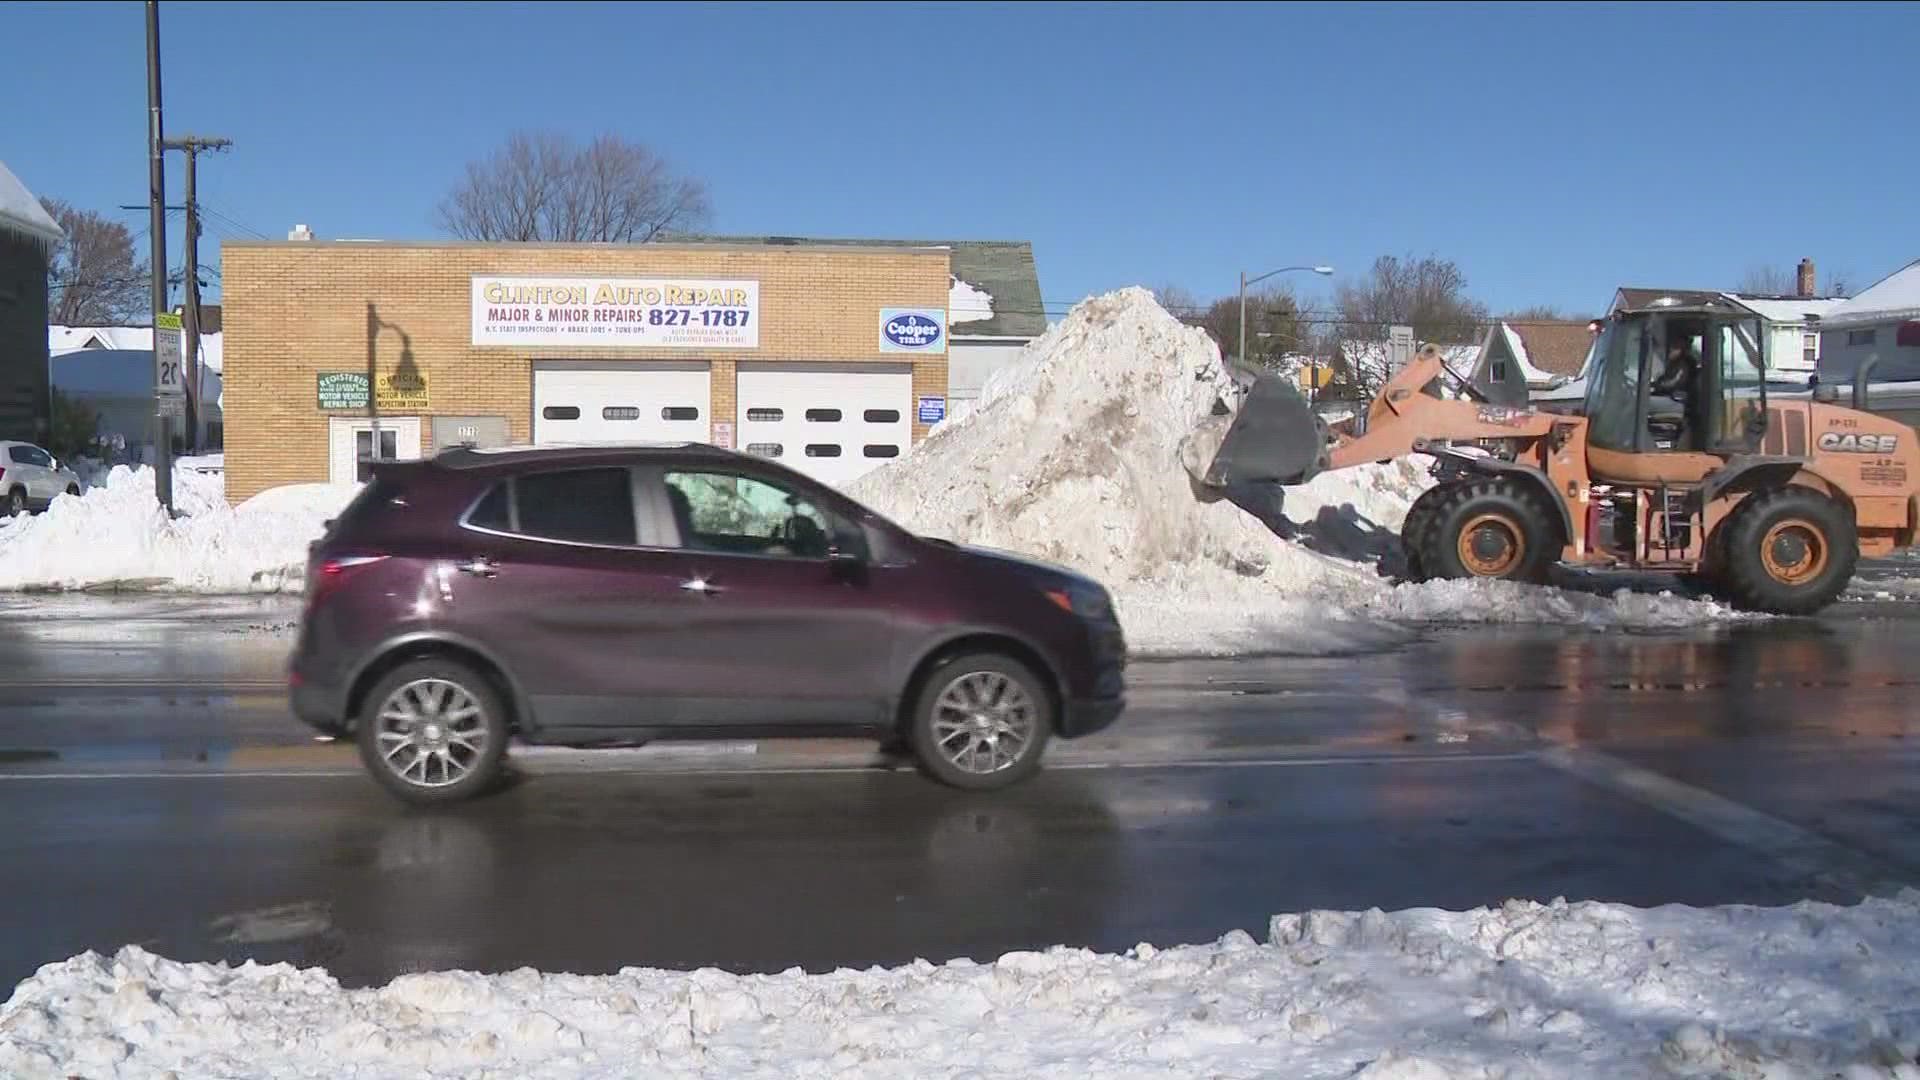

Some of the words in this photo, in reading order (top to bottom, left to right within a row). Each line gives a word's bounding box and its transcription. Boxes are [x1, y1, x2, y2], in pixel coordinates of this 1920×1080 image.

[483, 282, 587, 305] CLINTON
[593, 283, 661, 306] AUTO
[664, 284, 747, 307] REPAIR
[488, 308, 530, 321] MAJOR
[534, 309, 543, 321] &
[548, 309, 589, 322] MINOR
[593, 309, 643, 322] REPAIRS
[648, 309, 750, 327] 827-1787
[888, 322, 937, 338] Cooper
[160, 332, 176, 344] SPEE
[320, 374, 369, 387] REGISTERED
[319, 392, 341, 400] MOTOR
[343, 392, 369, 400] VEHICLE
[377, 391, 398, 399] MOTOR
[401, 391, 427, 399] VEHICLE
[323, 400, 347, 408] REPAIR
[1818, 433, 1897, 453] CASE
